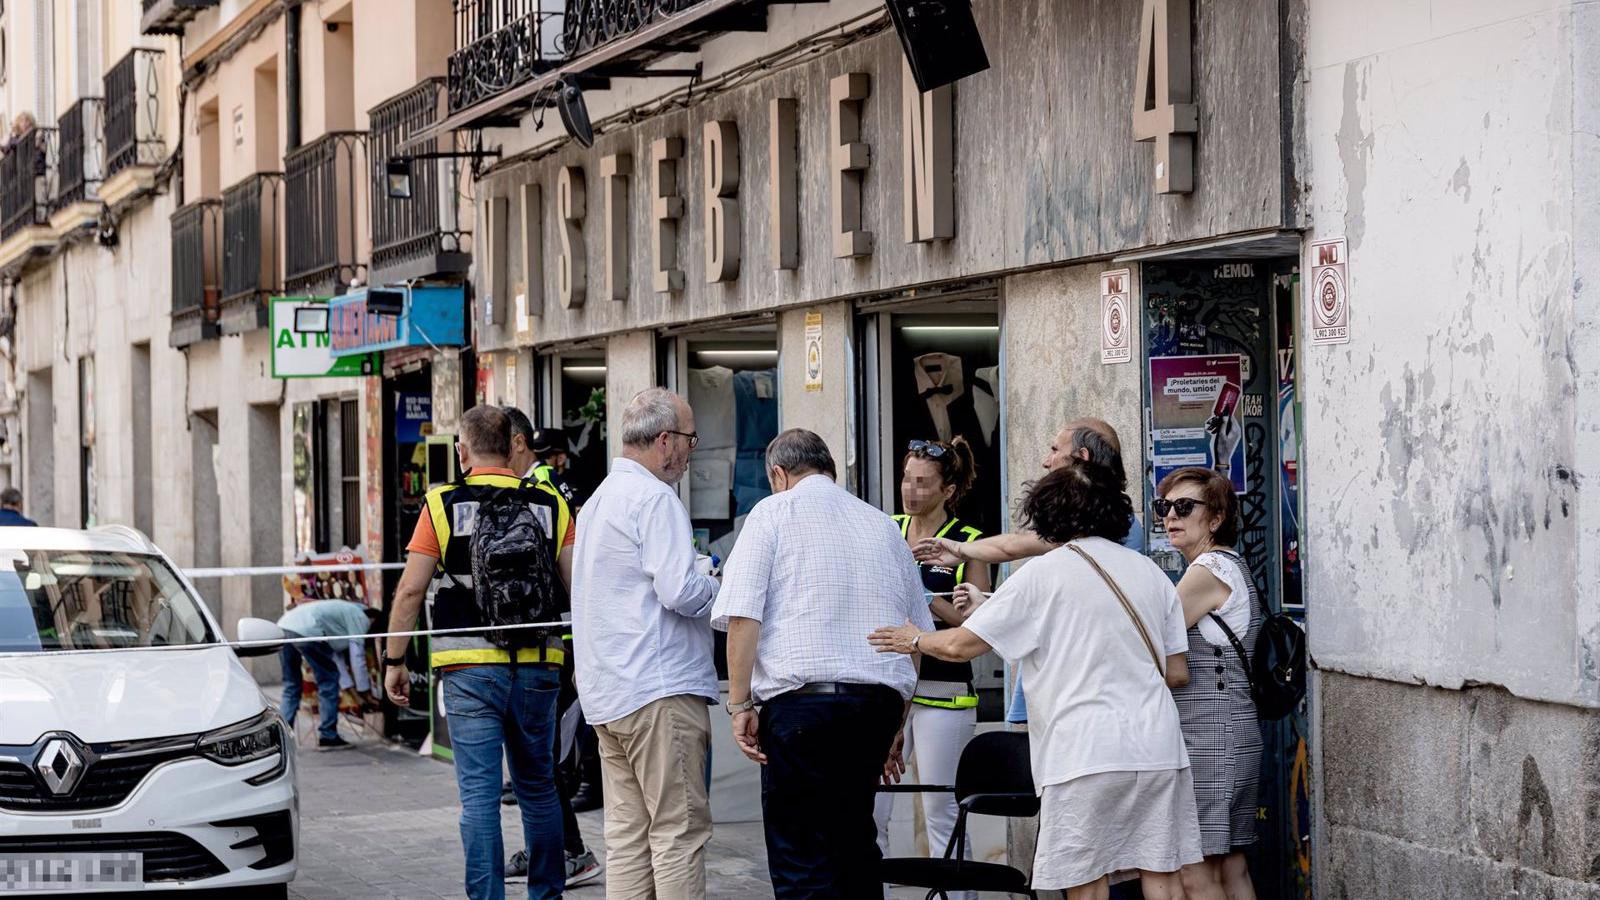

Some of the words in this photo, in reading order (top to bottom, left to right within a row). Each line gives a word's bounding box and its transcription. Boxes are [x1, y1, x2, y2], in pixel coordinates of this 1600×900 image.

[478, 48, 954, 325] VISTEBIEN
[1133, 0, 1198, 194] 4
[1209, 377, 1220, 385] del
